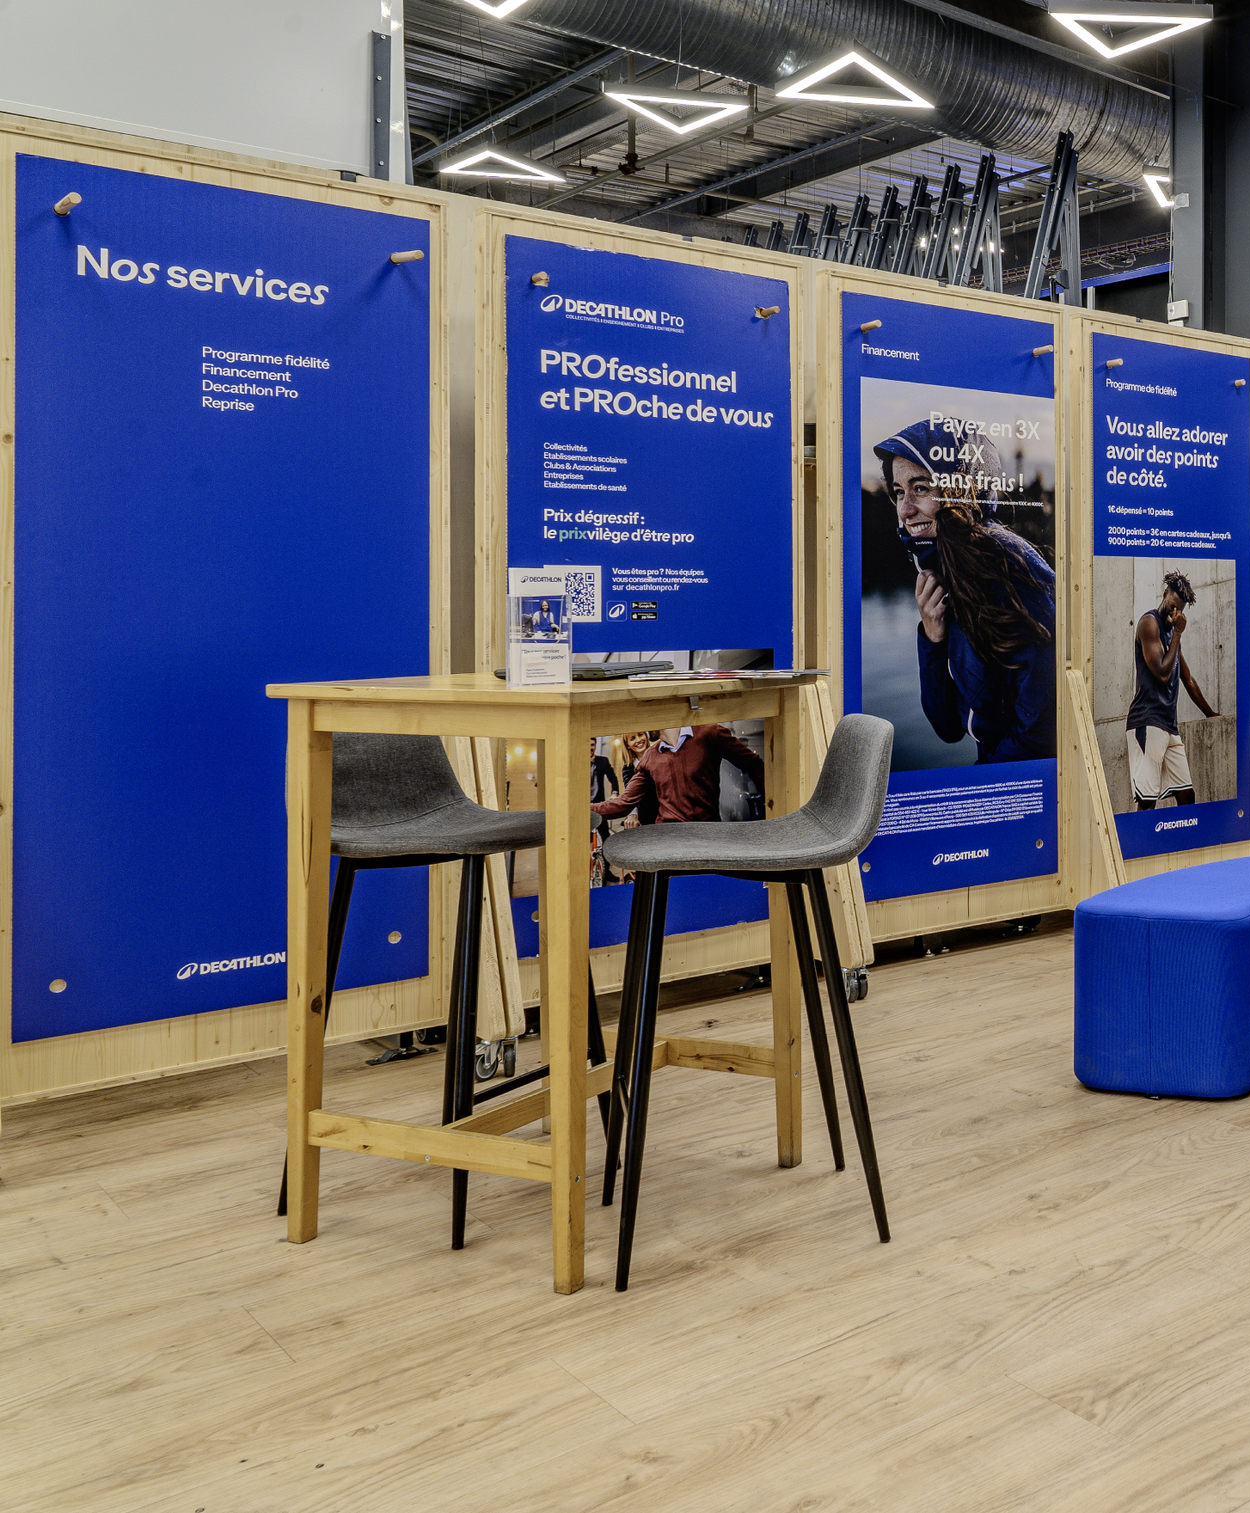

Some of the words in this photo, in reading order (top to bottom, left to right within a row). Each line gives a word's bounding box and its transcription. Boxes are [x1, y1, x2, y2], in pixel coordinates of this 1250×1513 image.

[76, 245, 159, 285] Nos
[166, 266, 329, 305] services
[565, 298, 656, 324] DECATHLON
[661, 312, 684, 327] Pro
[202, 346, 283, 367] Programme
[285, 354, 330, 370] fidélité
[861, 343, 920, 361] Financement
[202, 363, 291, 382] Financement
[540, 349, 737, 393] PROfessionnel
[202, 380, 273, 397] Decathlon
[275, 386, 298, 399] Pro
[1105, 378, 1146, 393] Programme
[1146, 384, 1155, 394] de
[1155, 386, 1177, 397] fidélité
[202, 396, 255, 412] Reprise
[540, 387, 570, 410] et
[574, 387, 684, 420] PROche
[686, 399, 717, 423] de
[720, 407, 774, 428] vous
[929, 411, 987, 437] Payez
[990, 422, 1012, 438] en
[1015, 419, 1041, 440] 3X
[1106, 415, 1145, 437] Vous
[1146, 421, 1180, 441] allez
[1182, 426, 1228, 446] adorer
[543, 442, 588, 452] Collectivités
[929, 445, 955, 462] ou
[958, 444, 985, 464] 4X
[1106, 443, 1145, 462] avoir
[1146, 445, 1172, 464] des
[1174, 449, 1219, 469] points
[543, 461, 565, 470] Clubs
[572, 463, 617, 472] Associations
[544, 452, 597, 462] Etablissements
[598, 456, 627, 464] scolaires
[544, 471, 584, 480] Entreprises
[929, 472, 971, 489] sans
[976, 471, 1016, 492] frais
[1019, 473, 1024, 492] !
[1106, 466, 1127, 485] de
[1129, 468, 1167, 488] côté.
[544, 480, 597, 490] Etablissements
[598, 483, 607, 491] de
[608, 484, 627, 492] santé
[543, 508, 573, 523] Prix
[575, 509, 639, 526] dégressif
[1108, 505, 1115, 513] 1€
[1116, 505, 1142, 516] dépensé
[1147, 507, 1155, 516] 10
[1155, 508, 1174, 517] points
[543, 526, 557, 539] le
[559, 527, 630, 544] prixvilège
[631, 528, 669, 543] d'être
[671, 532, 694, 545] pro
[1108, 526, 1126, 535] 2000
[1126, 528, 1145, 536] points
[1151, 528, 1159, 536] 3€
[1168, 530, 1186, 538] cartes
[1108, 538, 1126, 546] 9000
[1126, 538, 1145, 547] points
[1151, 539, 1159, 547] 20
[1173, 540, 1190, 548] cartes
[626, 584, 680, 592] decathlonpro.fr
[1163, 818, 1198, 830] DECATHLON
[944, 848, 989, 863] DECATHLON
[200, 951, 286, 975] DECATHLON
